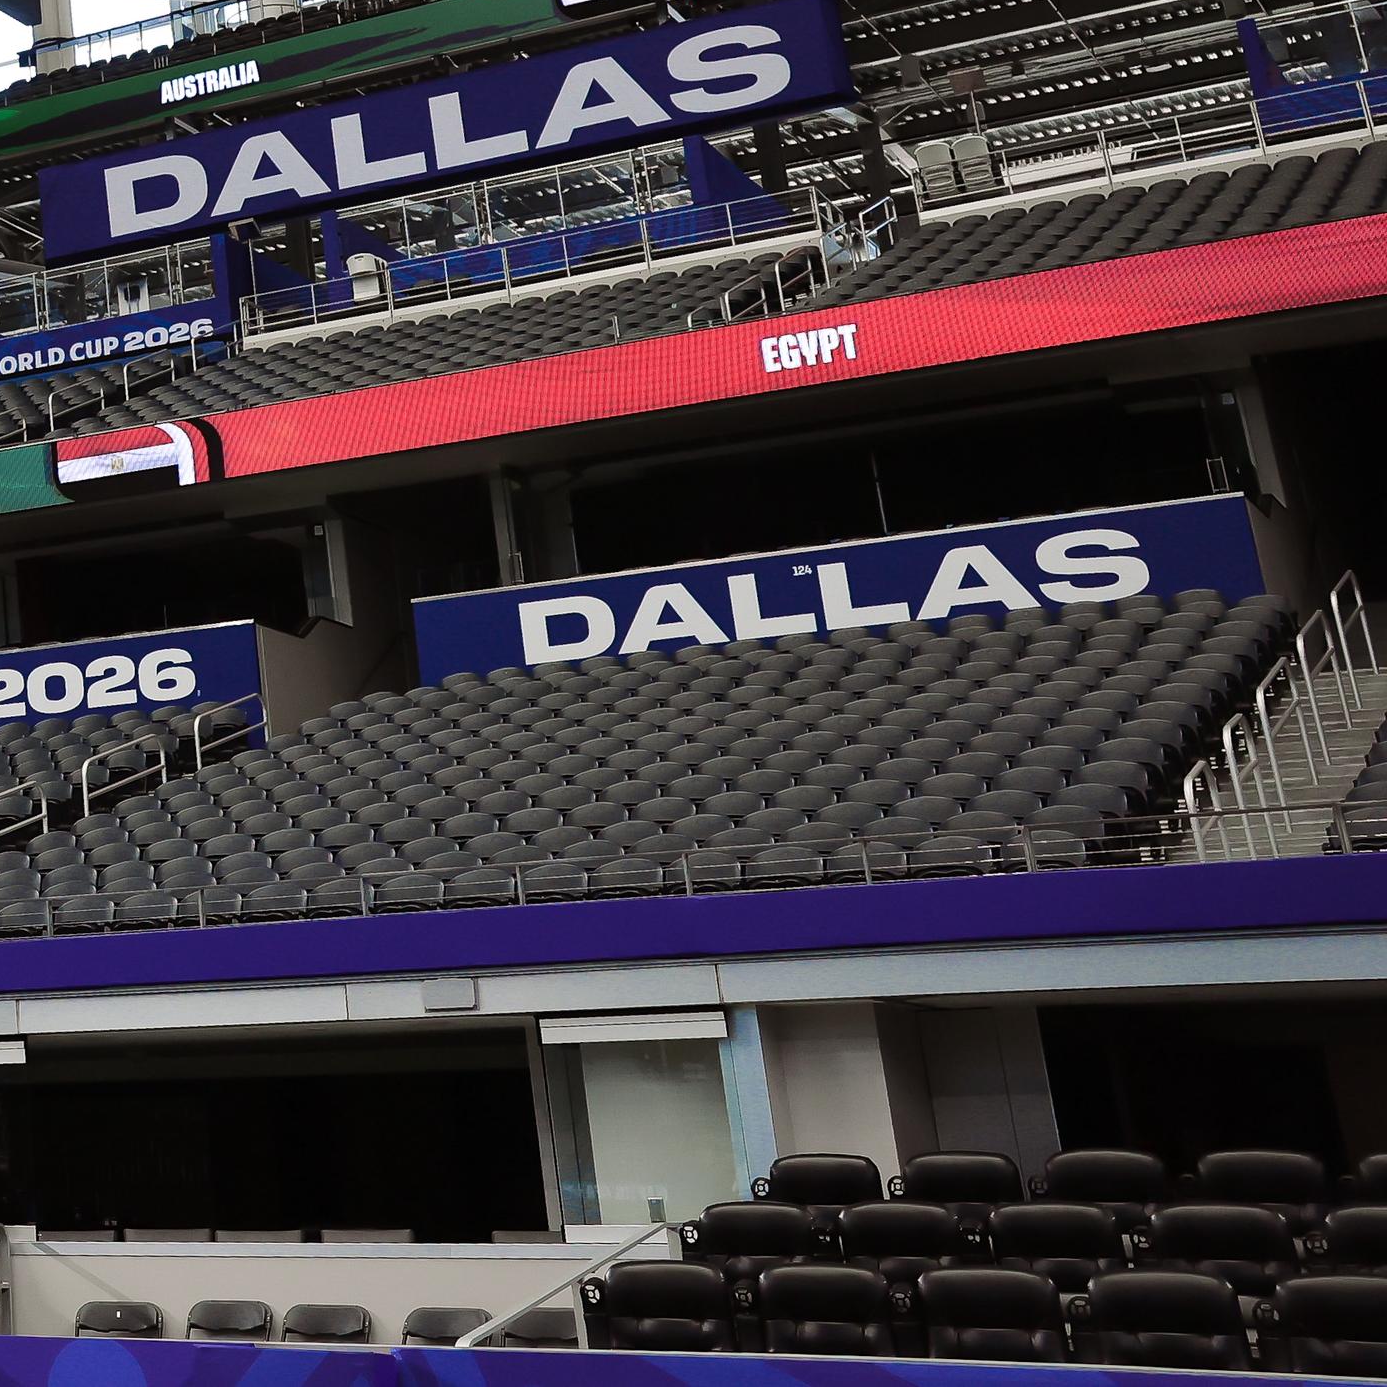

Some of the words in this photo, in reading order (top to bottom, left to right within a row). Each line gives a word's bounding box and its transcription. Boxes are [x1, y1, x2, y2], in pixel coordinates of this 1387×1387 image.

[160, 60, 260, 105] AUSTRALIA
[103, 24, 791, 238] DALLAS
[69, 336, 119, 361] CUP
[123, 318, 214, 352] 2026
[761, 323, 858, 373] EGYPT
[792, 564, 812, 576] 124
[518, 528, 1150, 665] DALLAS
